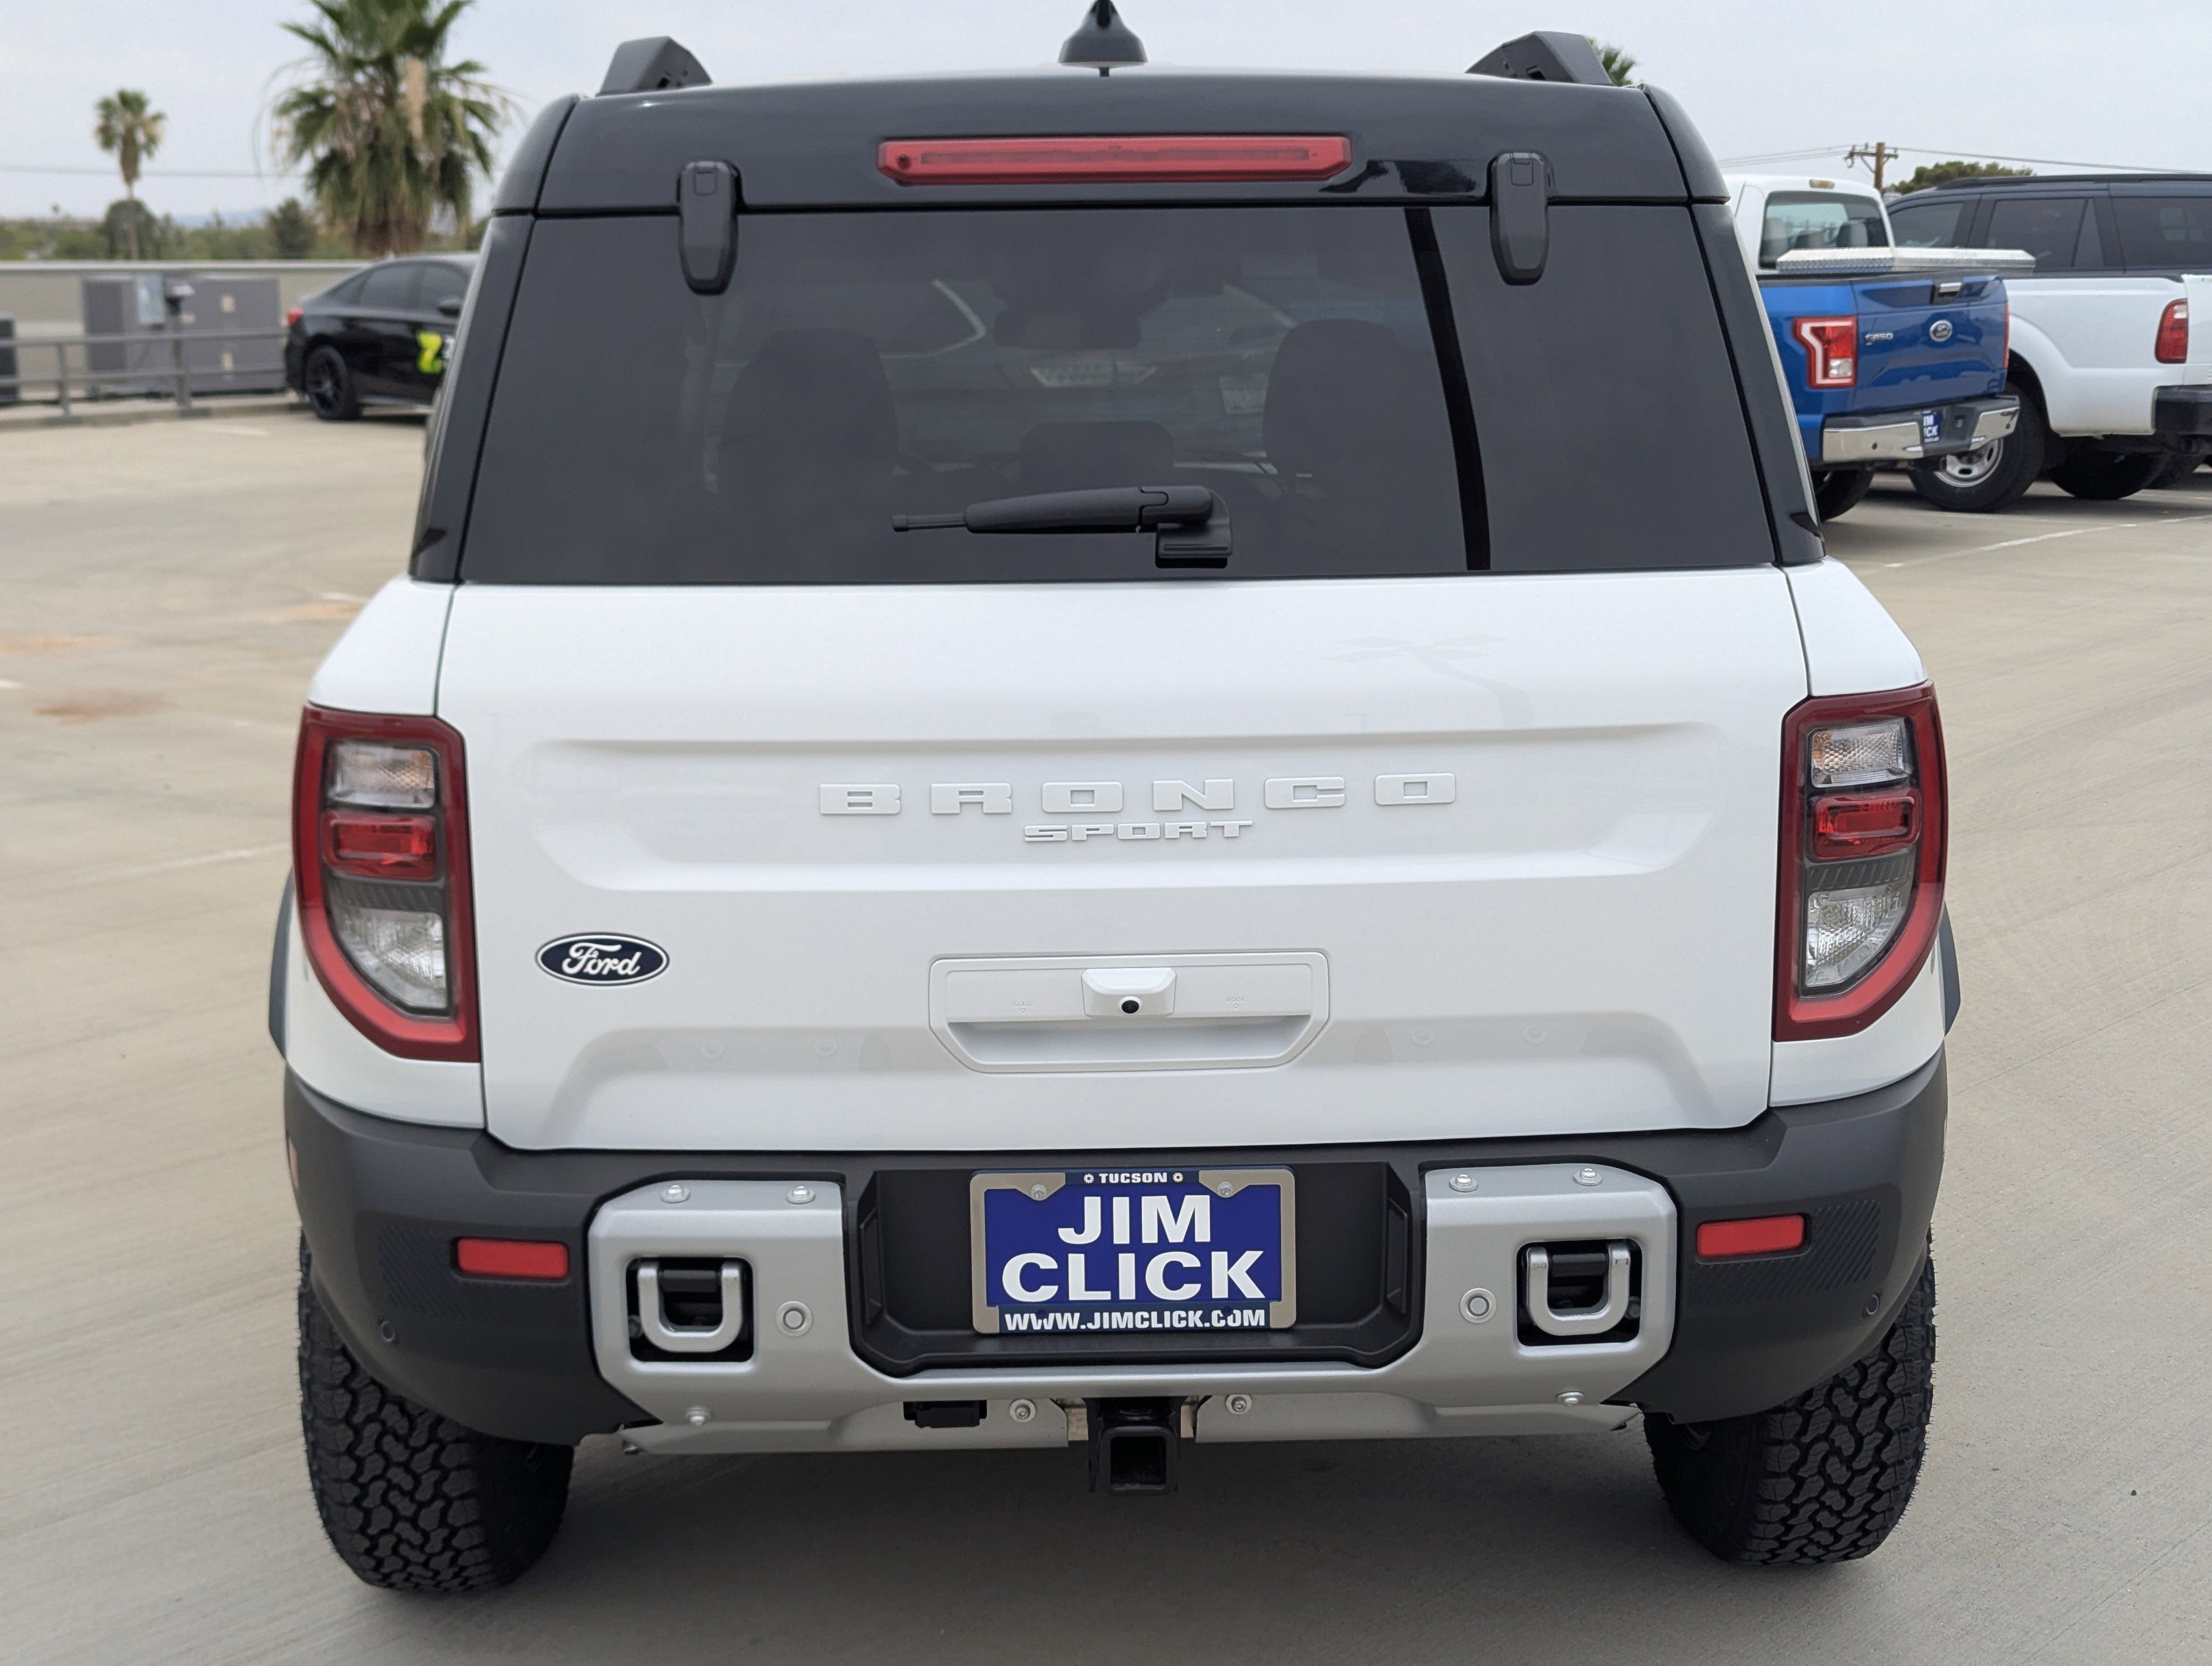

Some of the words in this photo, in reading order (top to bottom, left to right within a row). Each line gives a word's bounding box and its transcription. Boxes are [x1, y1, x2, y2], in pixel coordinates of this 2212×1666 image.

[1924, 414, 1934, 426] IM
[1924, 425, 1939, 437] ICK
[820, 772, 1456, 815] BRONCO
[1024, 819, 1253, 842] SPORT
[561, 942, 642, 976] Ford
[1098, 1172, 1168, 1183] TUCSON
[1057, 1194, 1211, 1245] JIM
[1001, 1250, 1266, 1303] CLICK
[1005, 1309, 1265, 1331] WWW.JIMCLICK.COM
